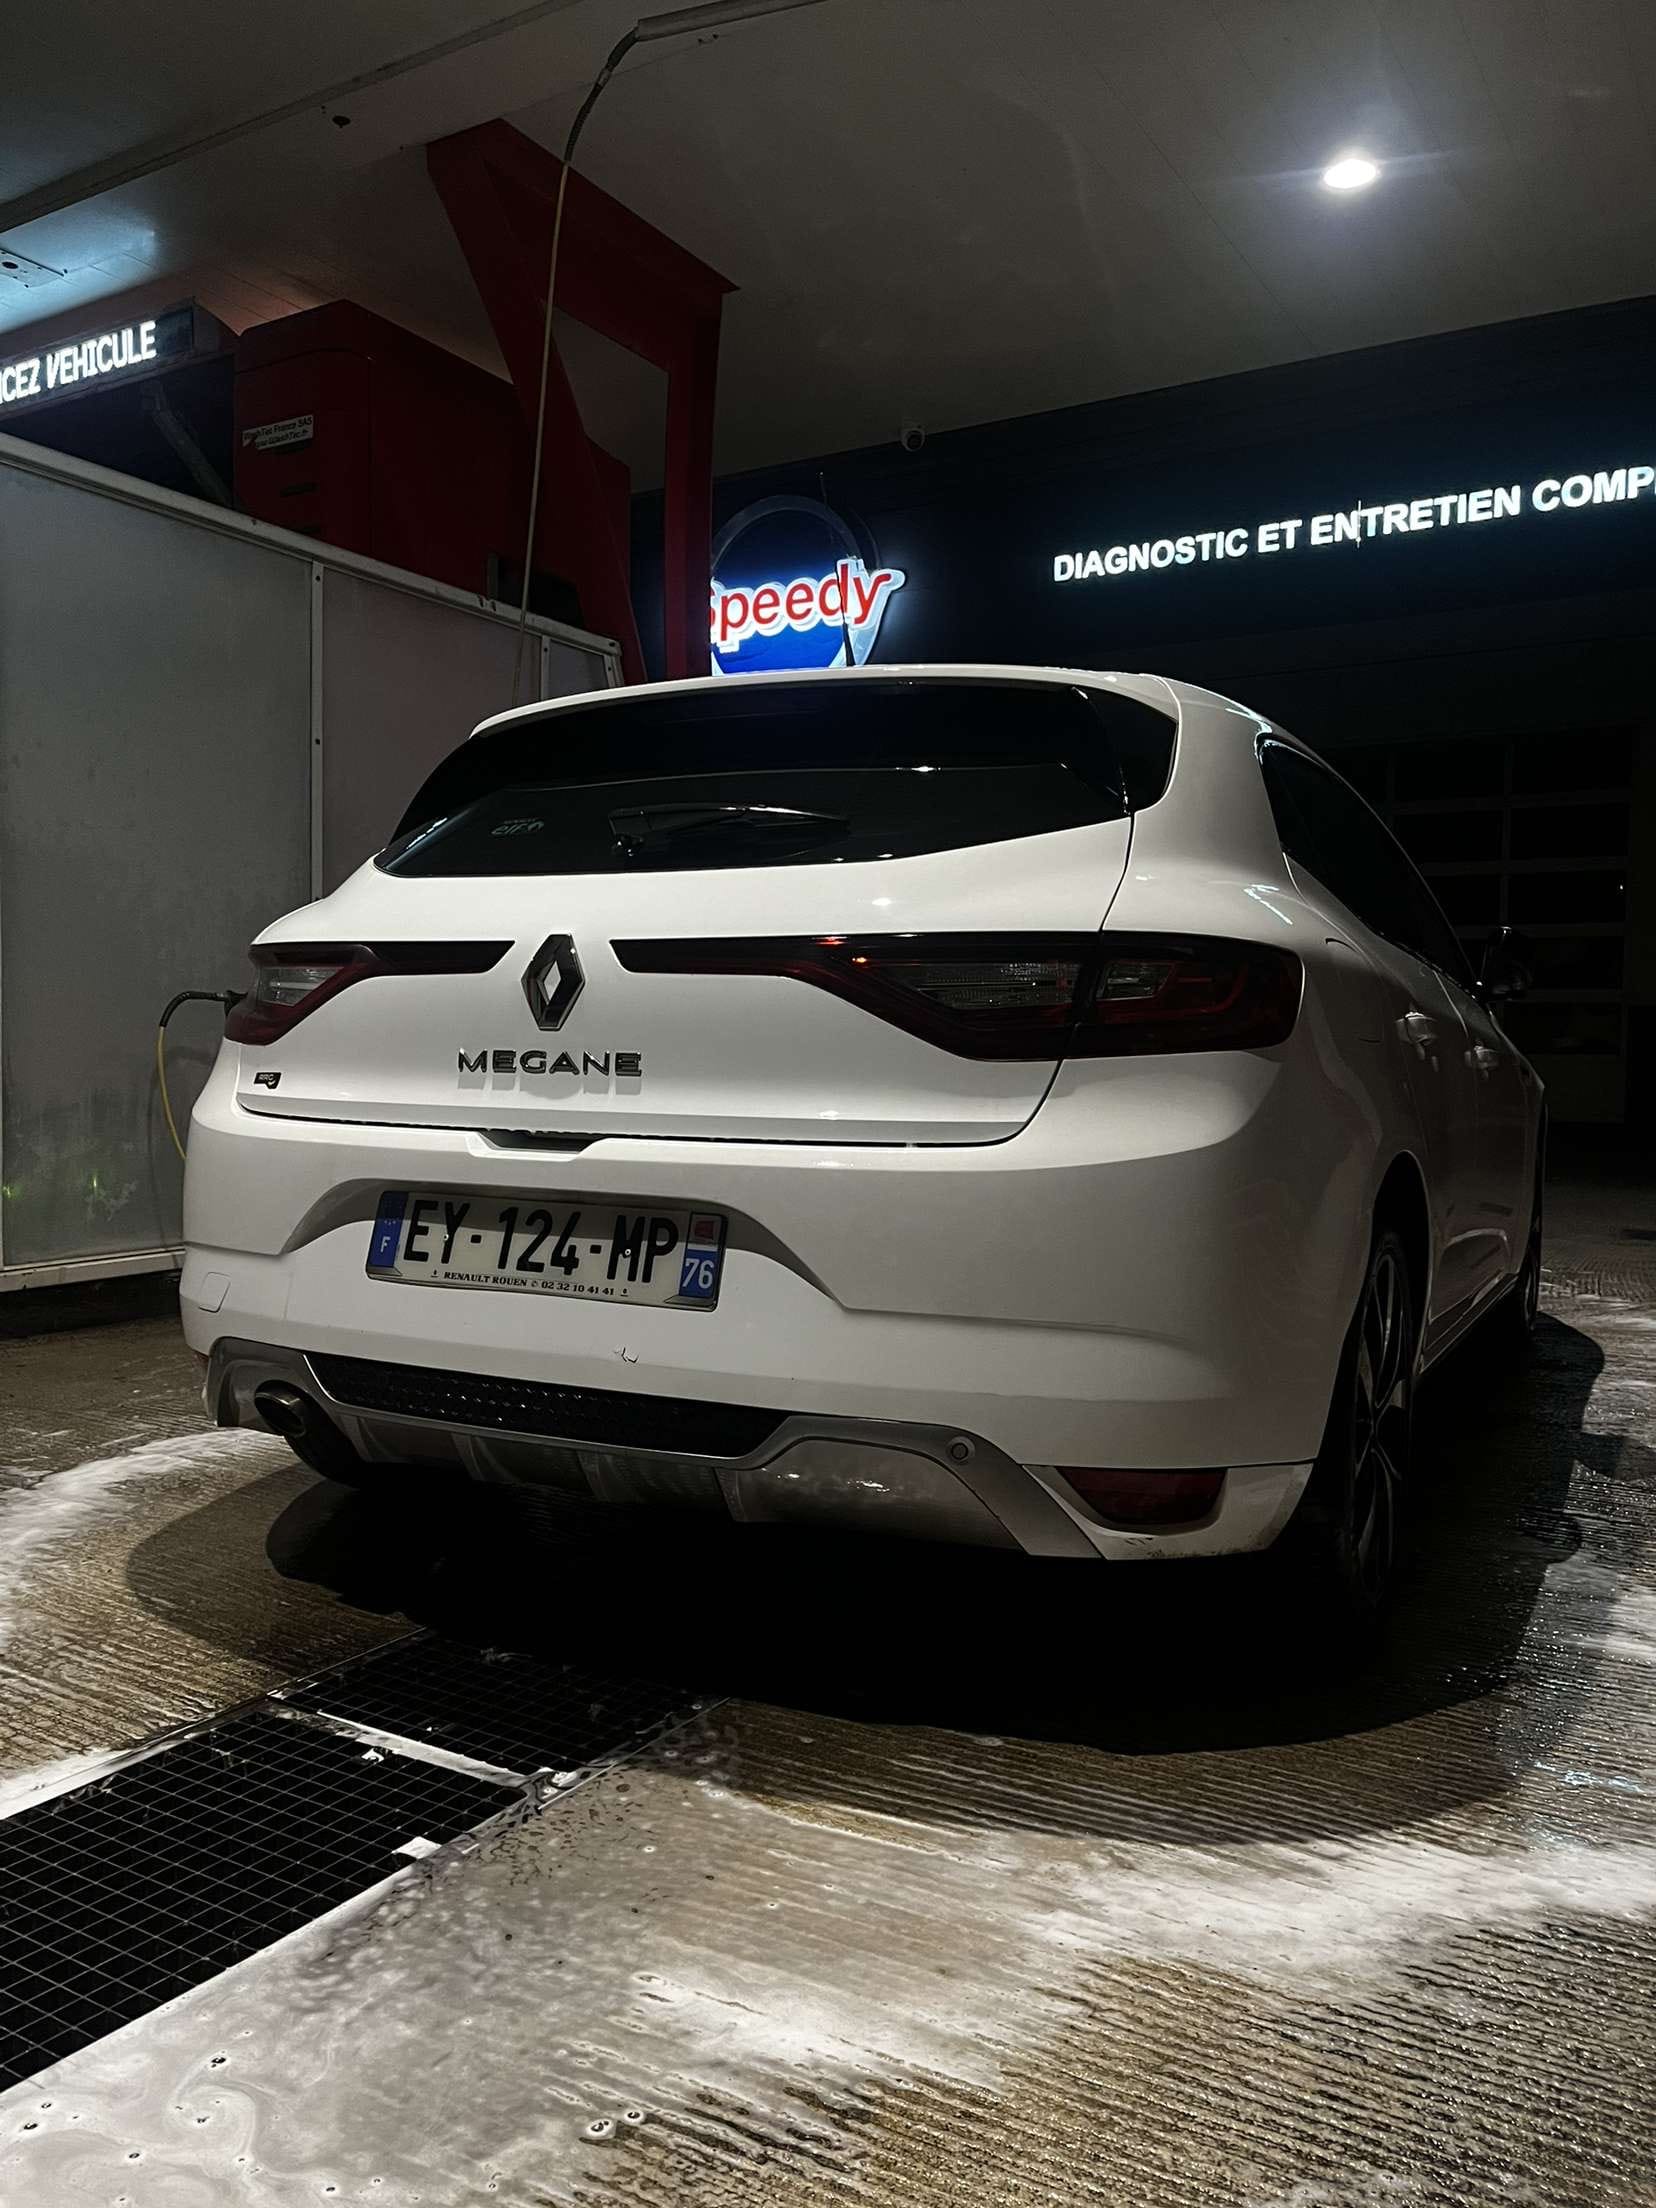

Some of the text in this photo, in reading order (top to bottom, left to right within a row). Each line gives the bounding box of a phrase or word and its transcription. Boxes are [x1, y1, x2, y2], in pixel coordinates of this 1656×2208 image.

[0, 320, 157, 404] CEZ VEHICULE
[1053, 466, 1656, 581] DIAGNOSTIC ET ENTRETIEN COMP
[457, 1049, 643, 1077] MEGANE
[380, 1236, 391, 1253] F
[444, 1271, 614, 1296] RENAULT ROUEN 02 32 10 41 41
[681, 1258, 714, 1289] 76
